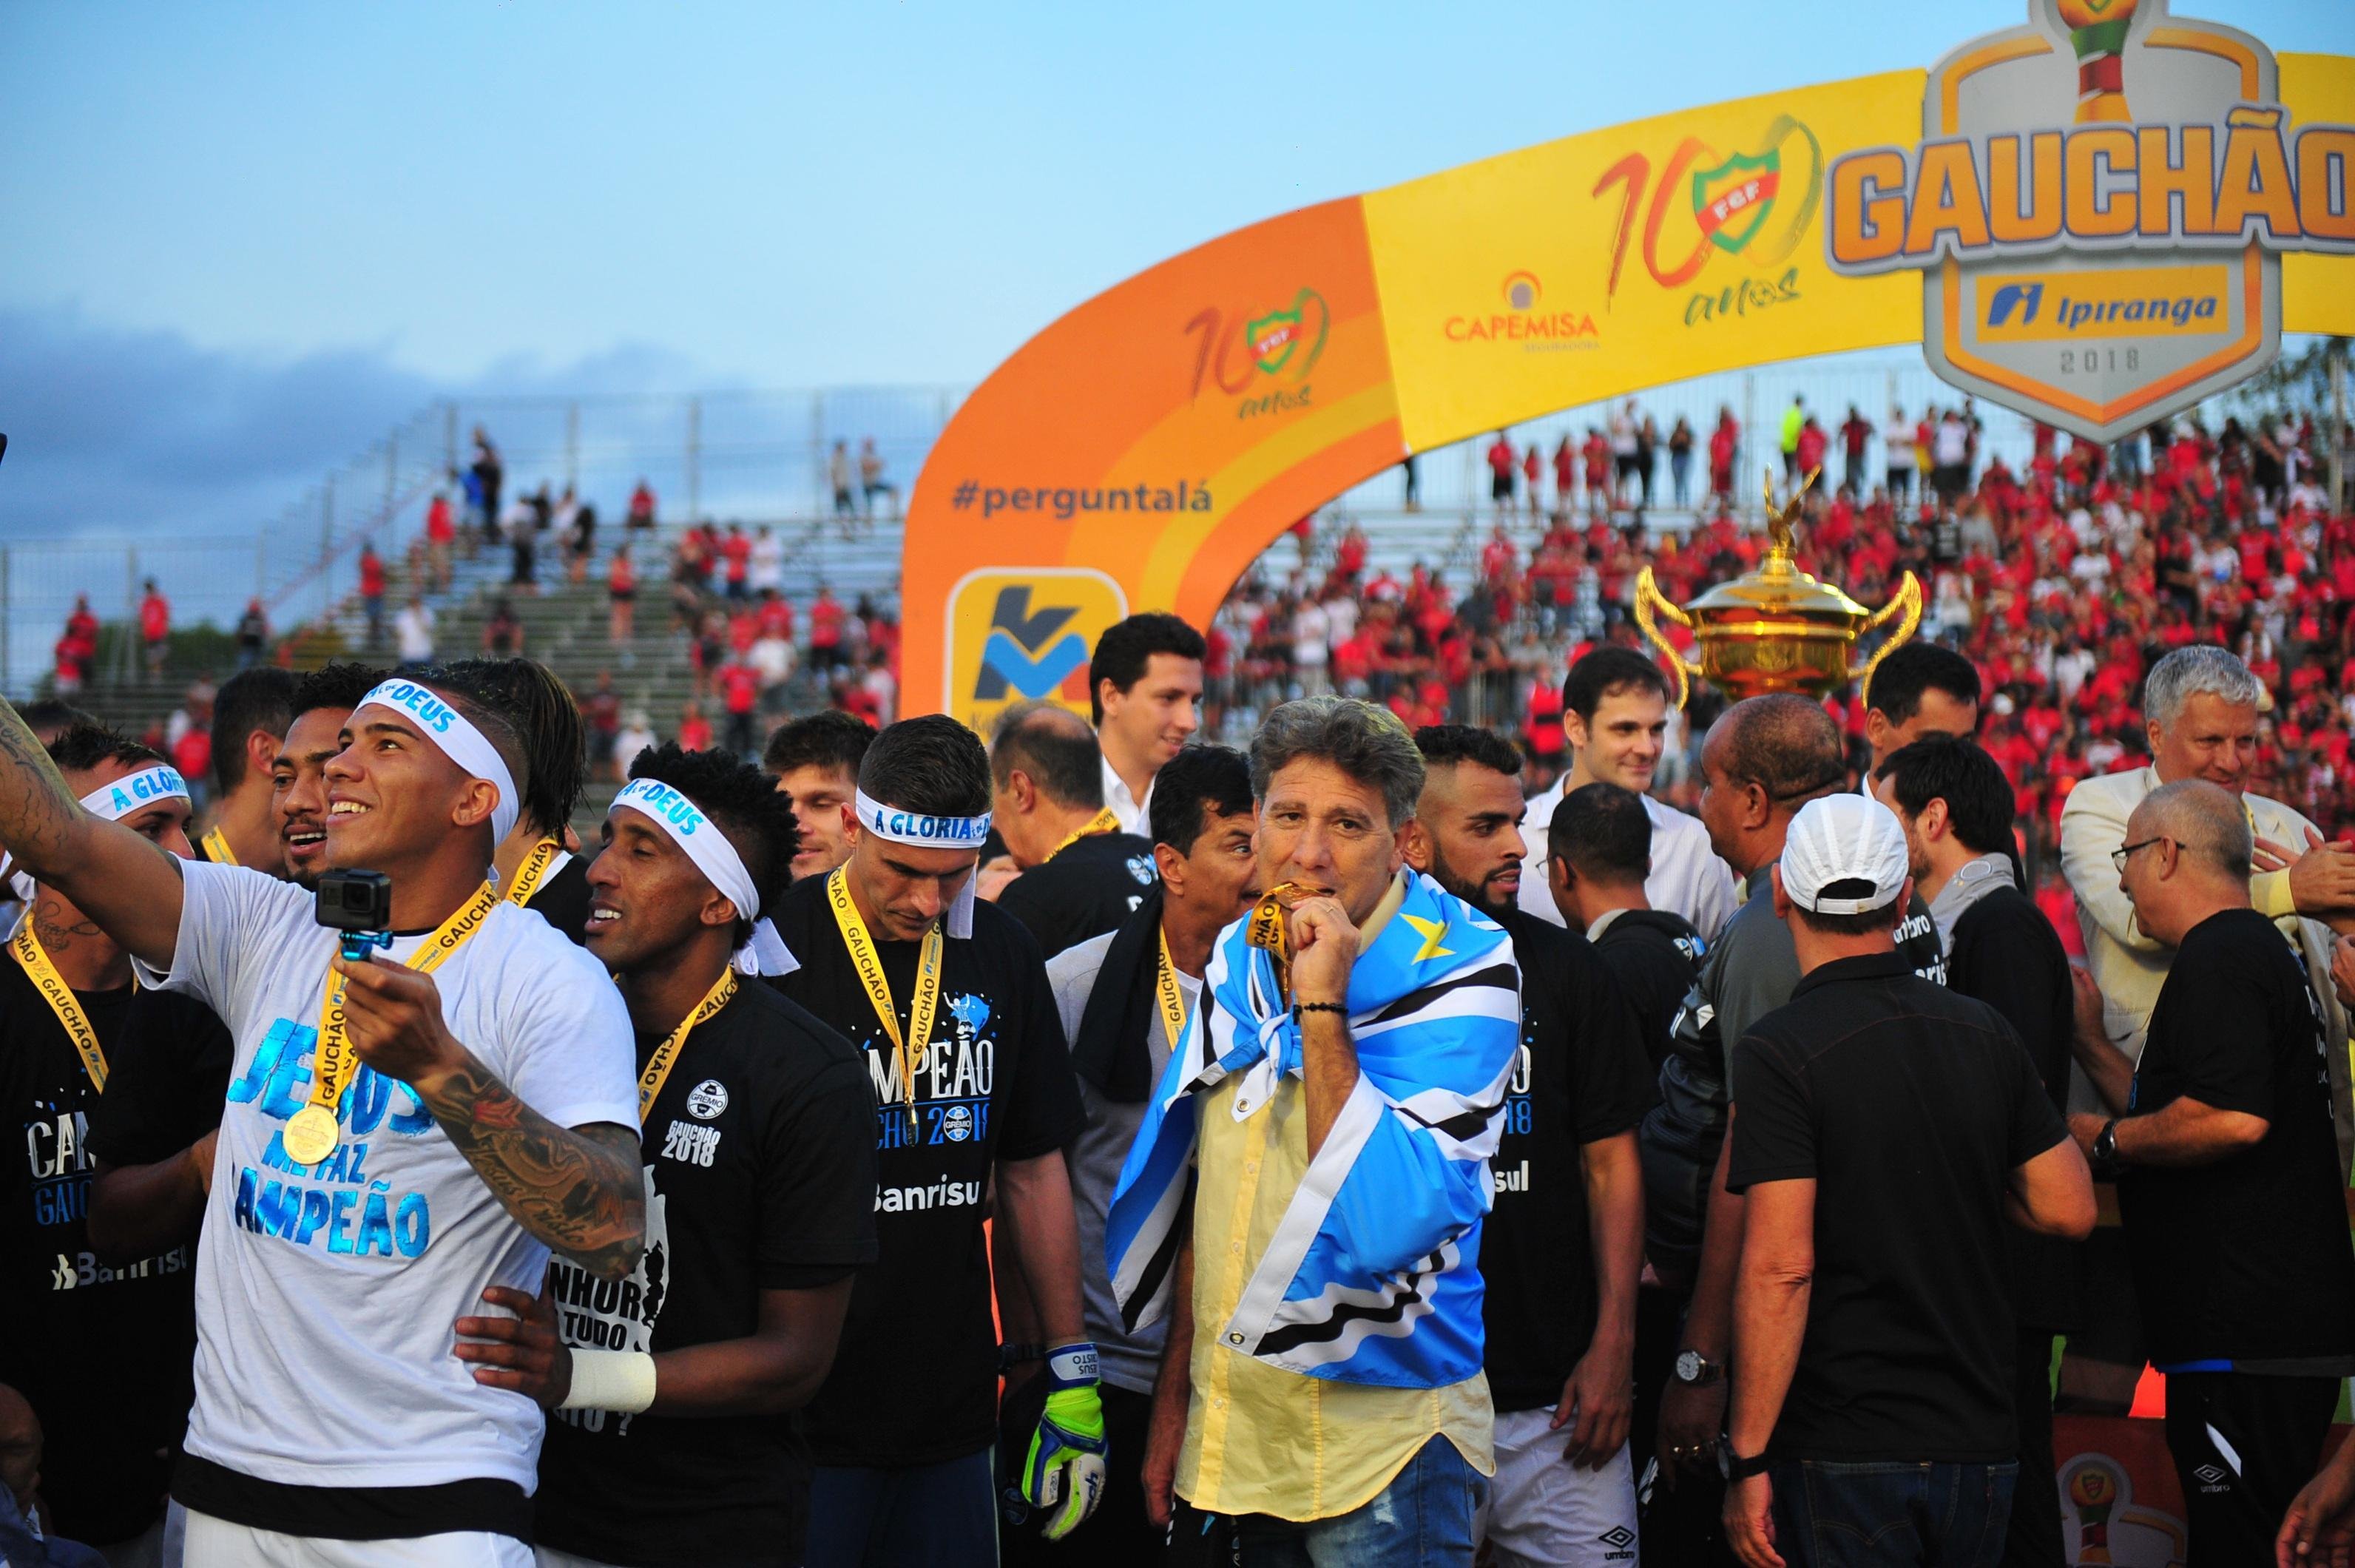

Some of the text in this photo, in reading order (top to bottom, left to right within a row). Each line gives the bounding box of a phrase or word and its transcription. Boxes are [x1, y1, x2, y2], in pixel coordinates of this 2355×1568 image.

[1711, 180, 1760, 222] FGF
[1827, 105, 2355, 268] GAUCHÃO
[1684, 267, 1801, 327] anos
[2056, 295, 2217, 330] Ipiranga
[1445, 311, 1600, 343] CAPEMISA
[2060, 348, 2141, 375] 2018
[952, 479, 1213, 519] #perguntalá
[391, 683, 456, 732] DEUS
[111, 787, 132, 812] A
[642, 783, 704, 836] DEUS
[875, 809, 885, 833] A
[511, 844, 548, 906] AUCHÃO
[439, 889, 498, 949] GAUCHÃ
[1254, 905, 1275, 945] CHÃO
[848, 927, 886, 1001] GAUCHÃO
[41, 977, 92, 1051] GAUCHÃO
[913, 977, 935, 1055] GAUCHÃO
[322, 1008, 345, 1100] GAUCHÃO
[868, 1033, 994, 1104] MPEÃO
[668, 1119, 721, 1146] GAUCHÃO
[1505, 1101, 1532, 1135] 18
[661, 1132, 716, 1169] 2018
[234, 1166, 430, 1258] AMPEÃO
[873, 1173, 981, 1213] anrisu
[549, 1262, 642, 1322] NHOR
[564, 1311, 628, 1352] TUDO
[2201, 1483, 2230, 1493] umbro
